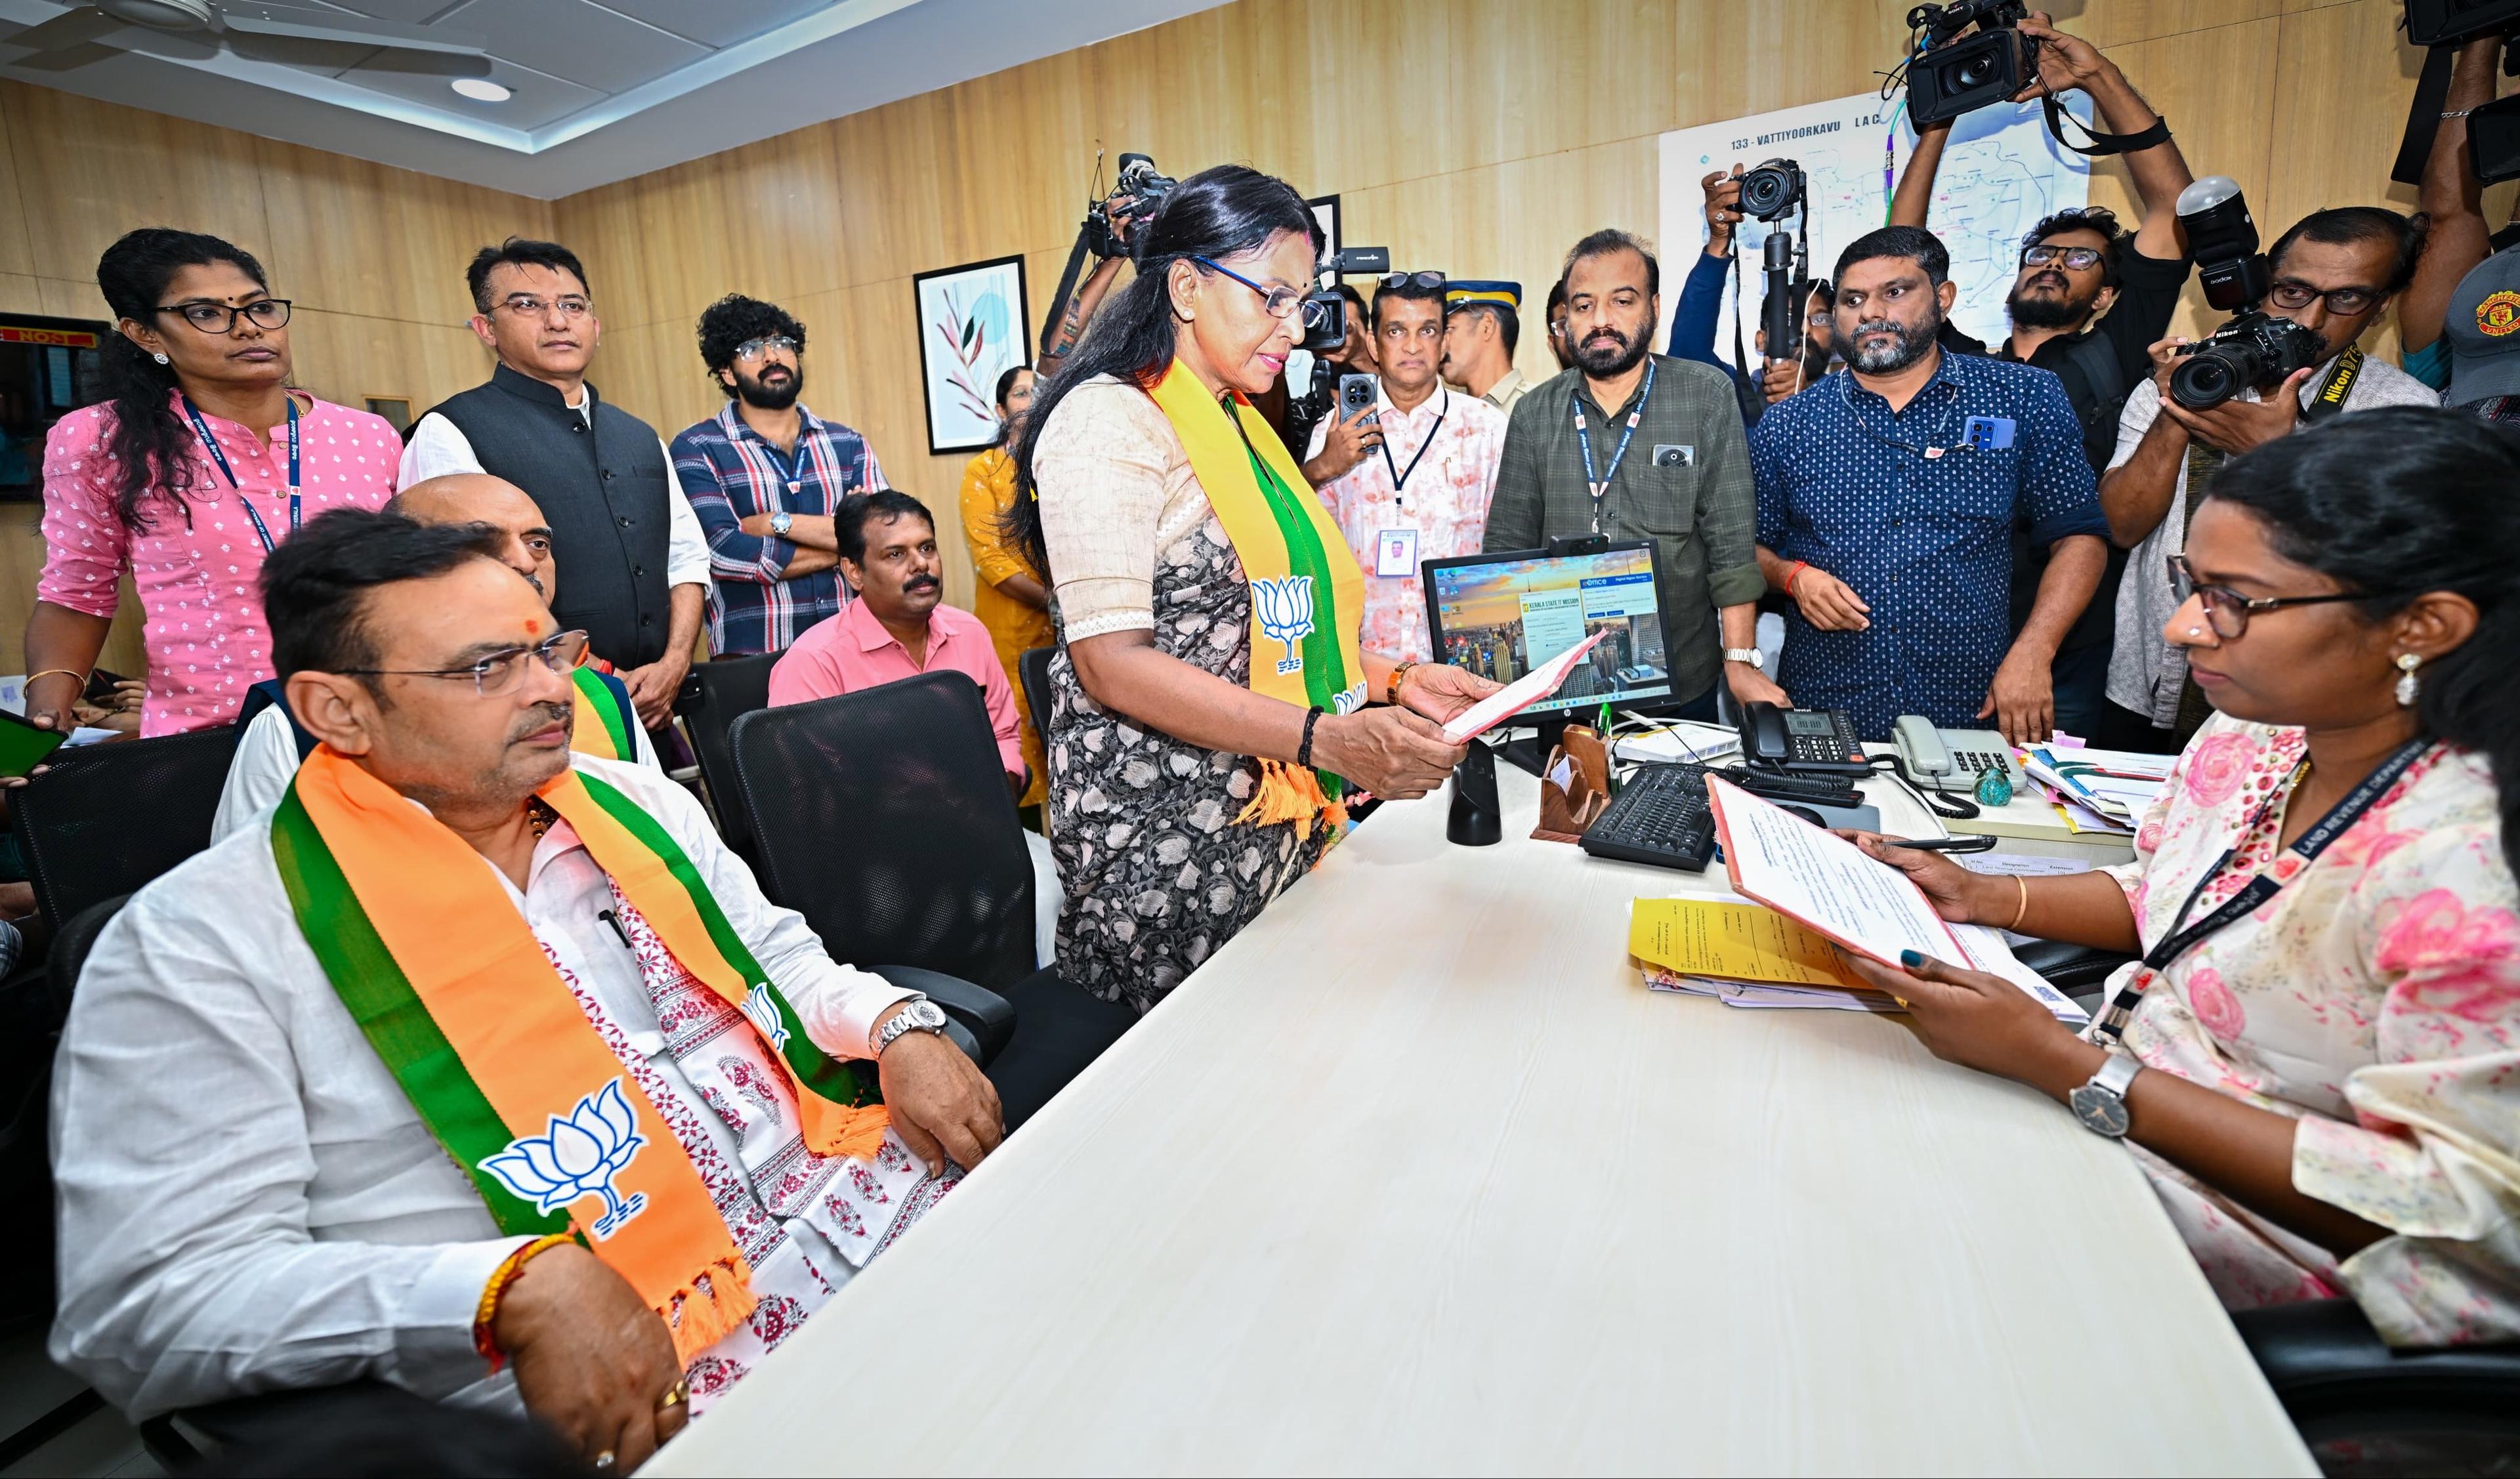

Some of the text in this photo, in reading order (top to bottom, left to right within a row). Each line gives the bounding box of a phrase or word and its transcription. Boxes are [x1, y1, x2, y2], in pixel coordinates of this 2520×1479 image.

[1948, 6, 1964, 14] SONY
[1731, 138, 1748, 150] 133
[1757, 121, 1841, 146] VATTIYOORKAVU
[2479, 295, 2520, 313] MANCHESTE
[2216, 329, 2238, 339] Nikon
[2487, 322, 2519, 334] UNITED
[2323, 369, 2352, 402] Nikon
[2299, 828, 2329, 855] LAND
[2323, 787, 2374, 831] REVENUE
